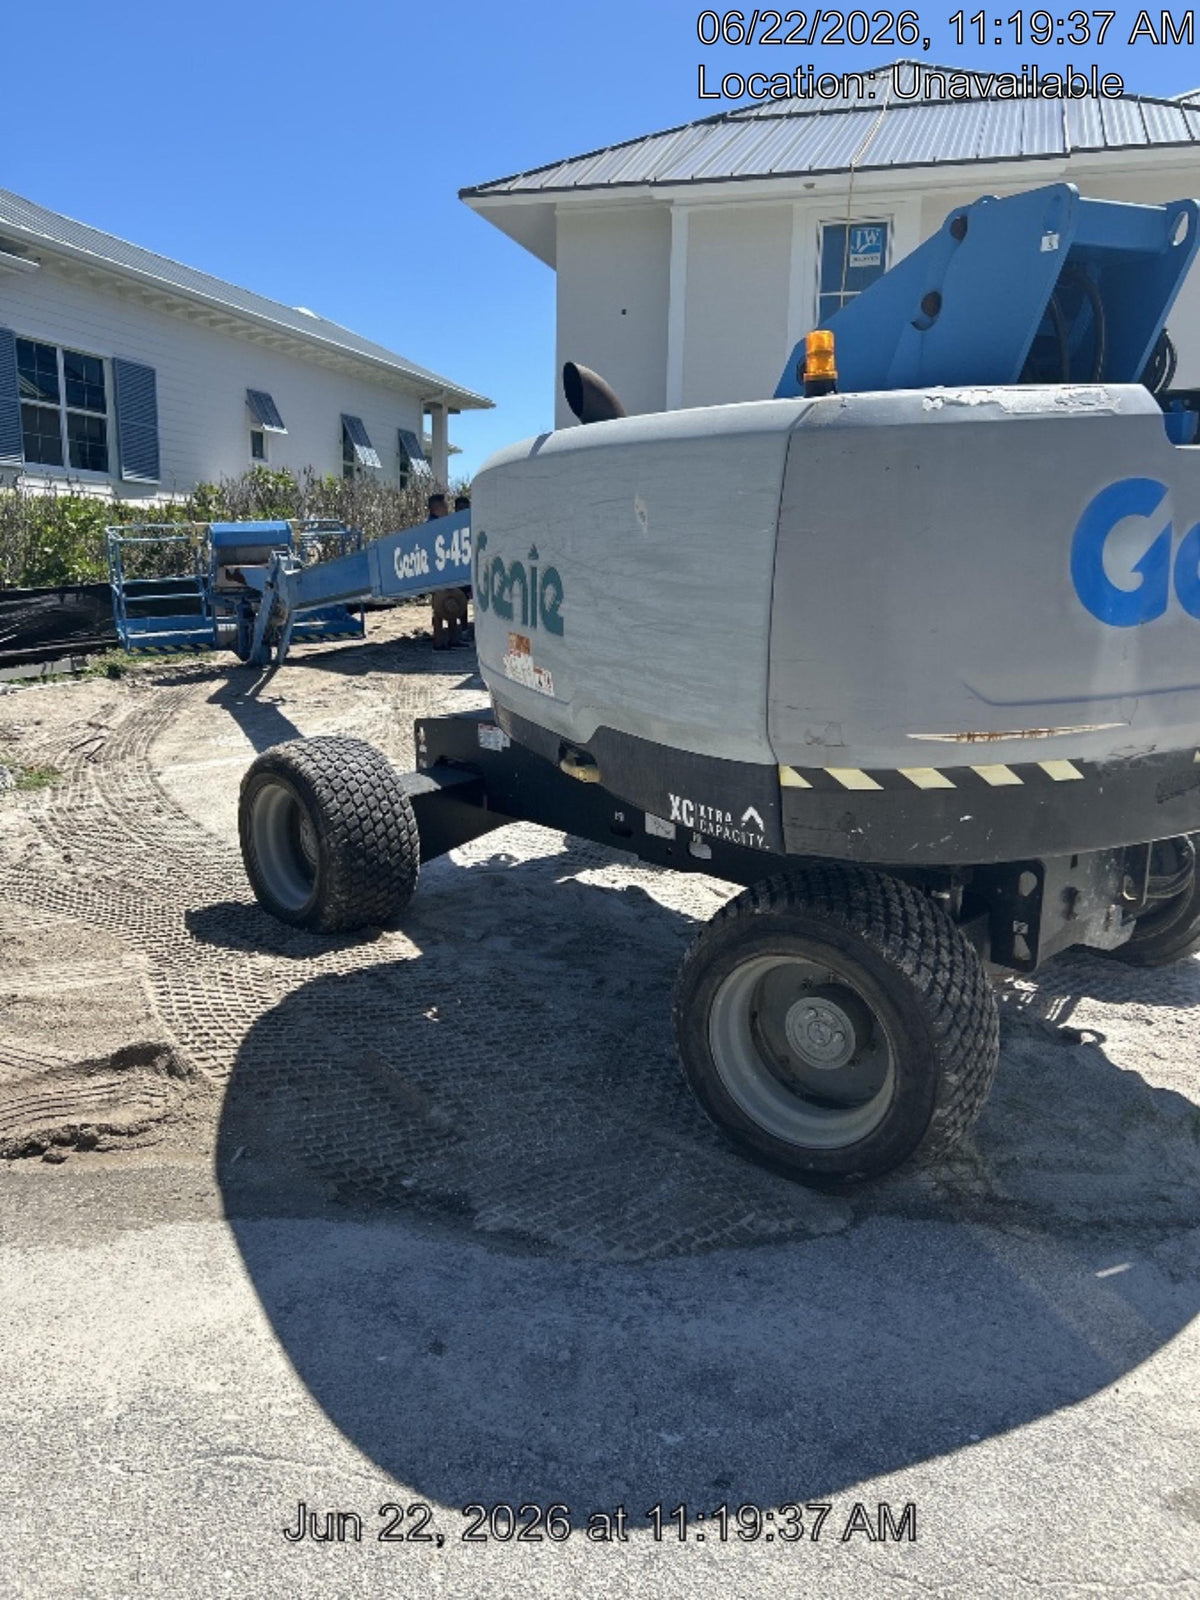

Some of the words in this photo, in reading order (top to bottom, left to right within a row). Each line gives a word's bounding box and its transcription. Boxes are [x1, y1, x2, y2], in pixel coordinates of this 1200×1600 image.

[394, 544, 430, 579] Genie
[475, 531, 564, 637] Genie
[668, 792, 694, 828] XC
[699, 819, 764, 849] CAPACITY
